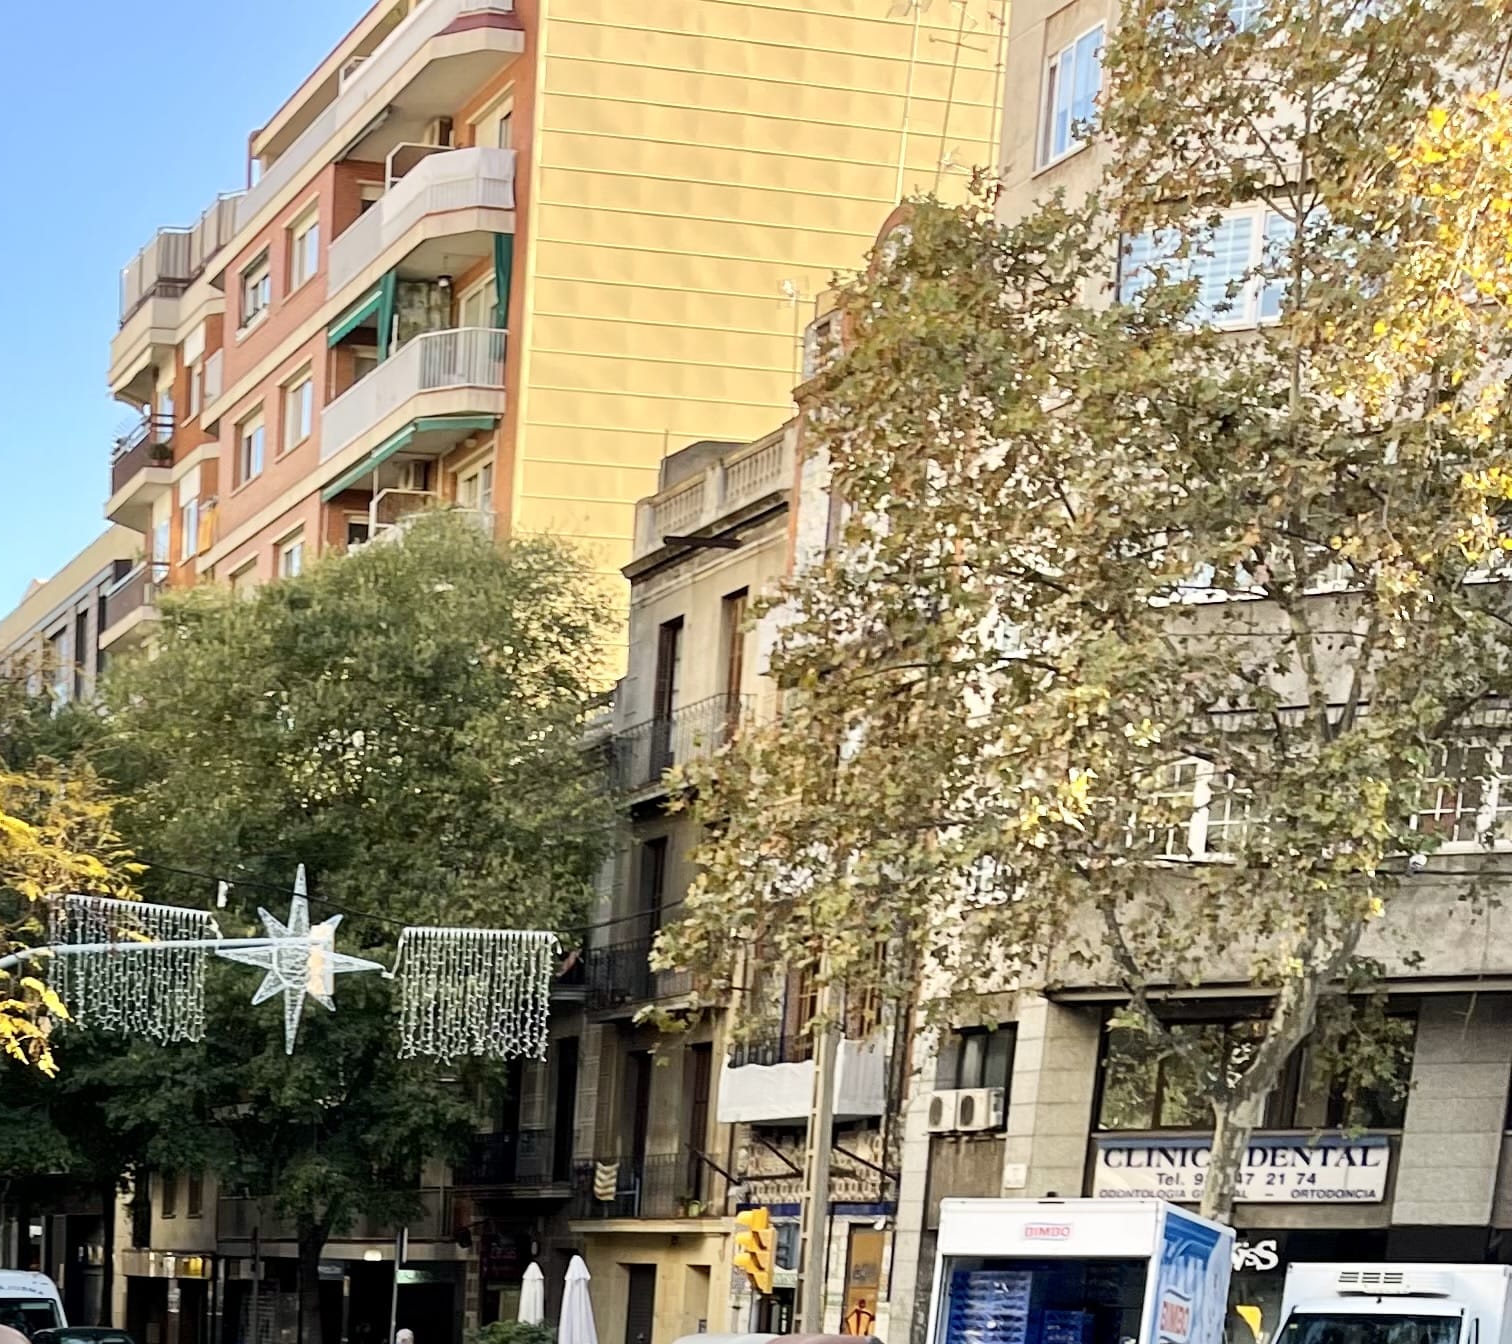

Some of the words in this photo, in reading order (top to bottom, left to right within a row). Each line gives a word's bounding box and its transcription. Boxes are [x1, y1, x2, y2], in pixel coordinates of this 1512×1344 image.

[1104, 1147, 1210, 1168] CLINIC
[1248, 1146, 1381, 1167] DENTAL
[1157, 1173, 1185, 1186] Tel.
[1266, 1172, 1285, 1185] 21
[1297, 1172, 1316, 1184] 74
[1099, 1189, 1186, 1199] ODONTOLOGIA
[1291, 1189, 1376, 1199] ORTODONCIA
[1025, 1226, 1070, 1238] BIMBO
